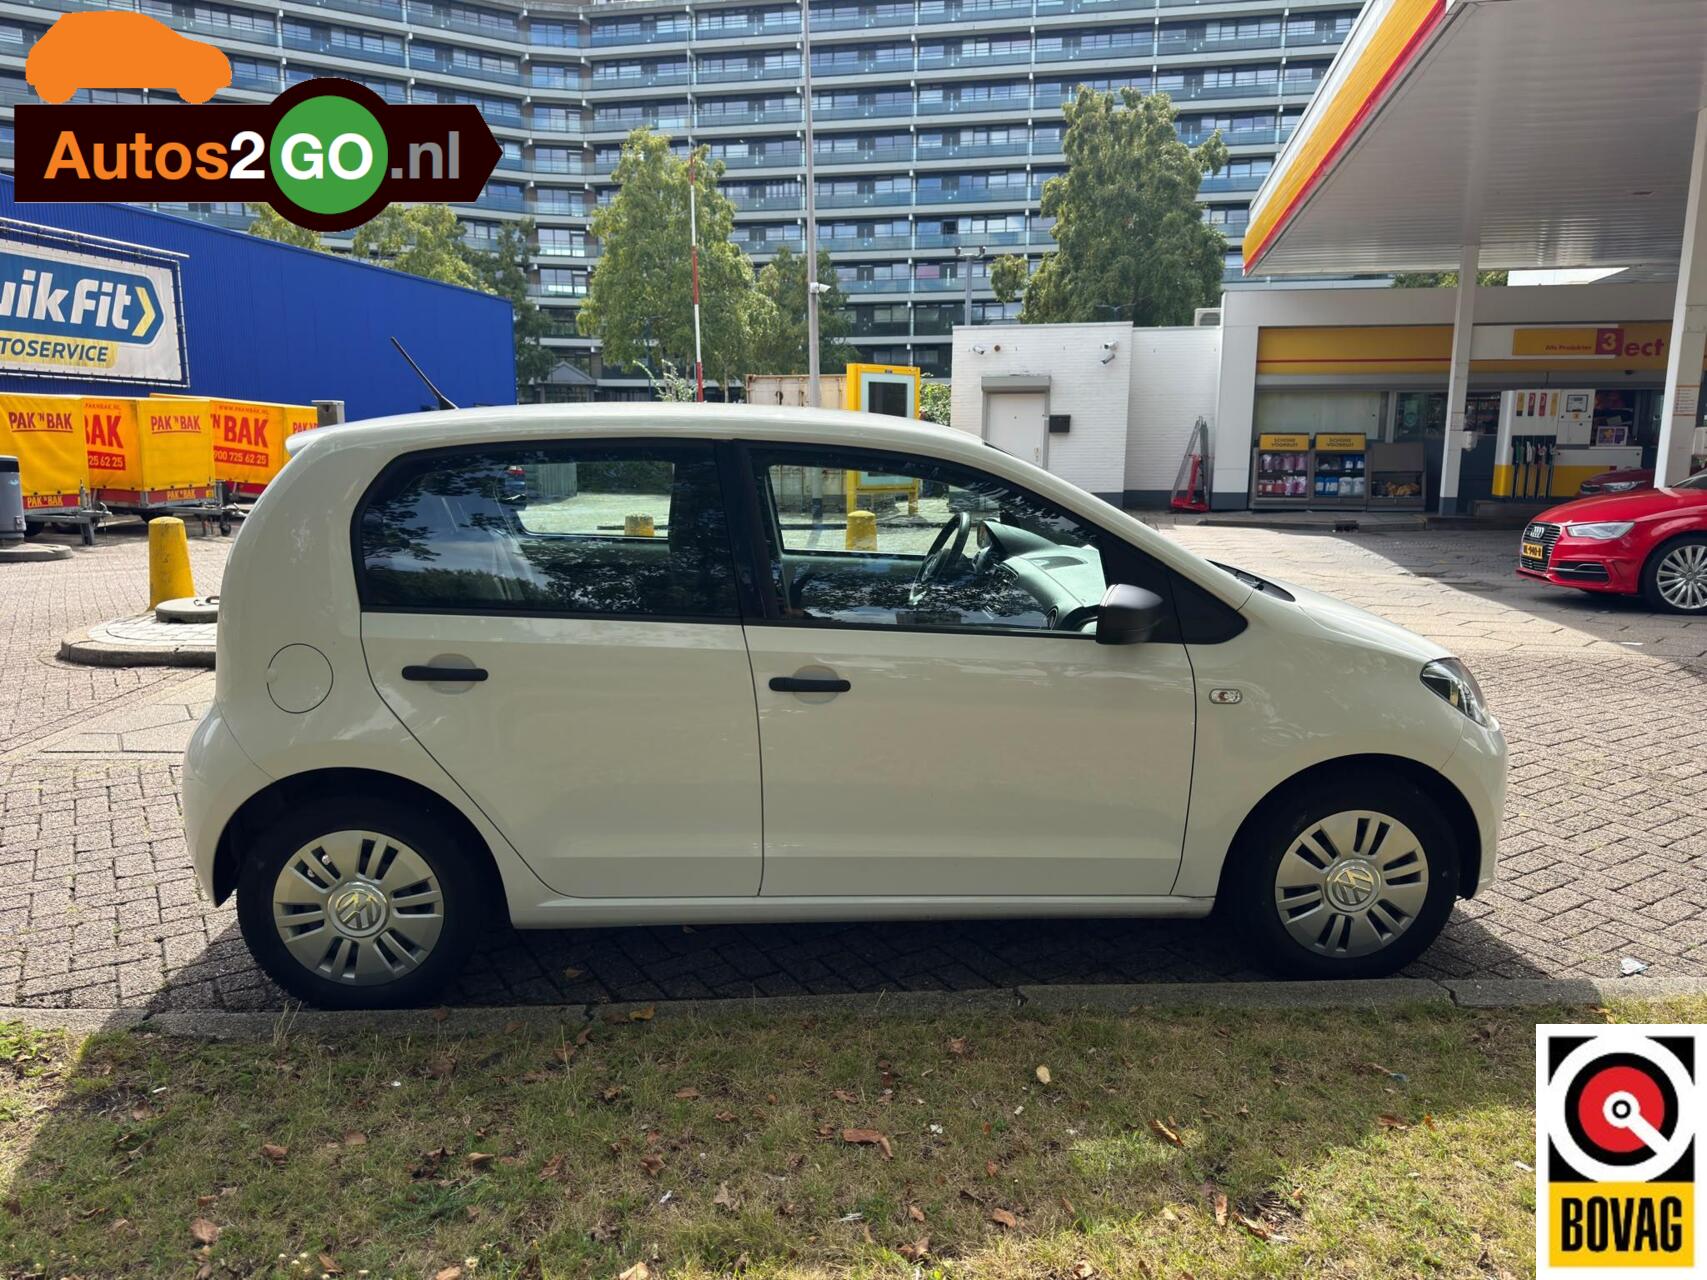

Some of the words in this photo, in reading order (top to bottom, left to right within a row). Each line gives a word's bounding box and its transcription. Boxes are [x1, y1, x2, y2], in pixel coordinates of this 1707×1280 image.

[9, 411, 36, 429] PAK
[46, 412, 73, 430] BAK
[151, 415, 172, 431] PAK
[180, 416, 201, 431] BAK
[224, 415, 269, 449] BAK
[100, 457, 111, 467] 62
[112, 457, 123, 467] 25
[256, 454, 267, 464] 25
